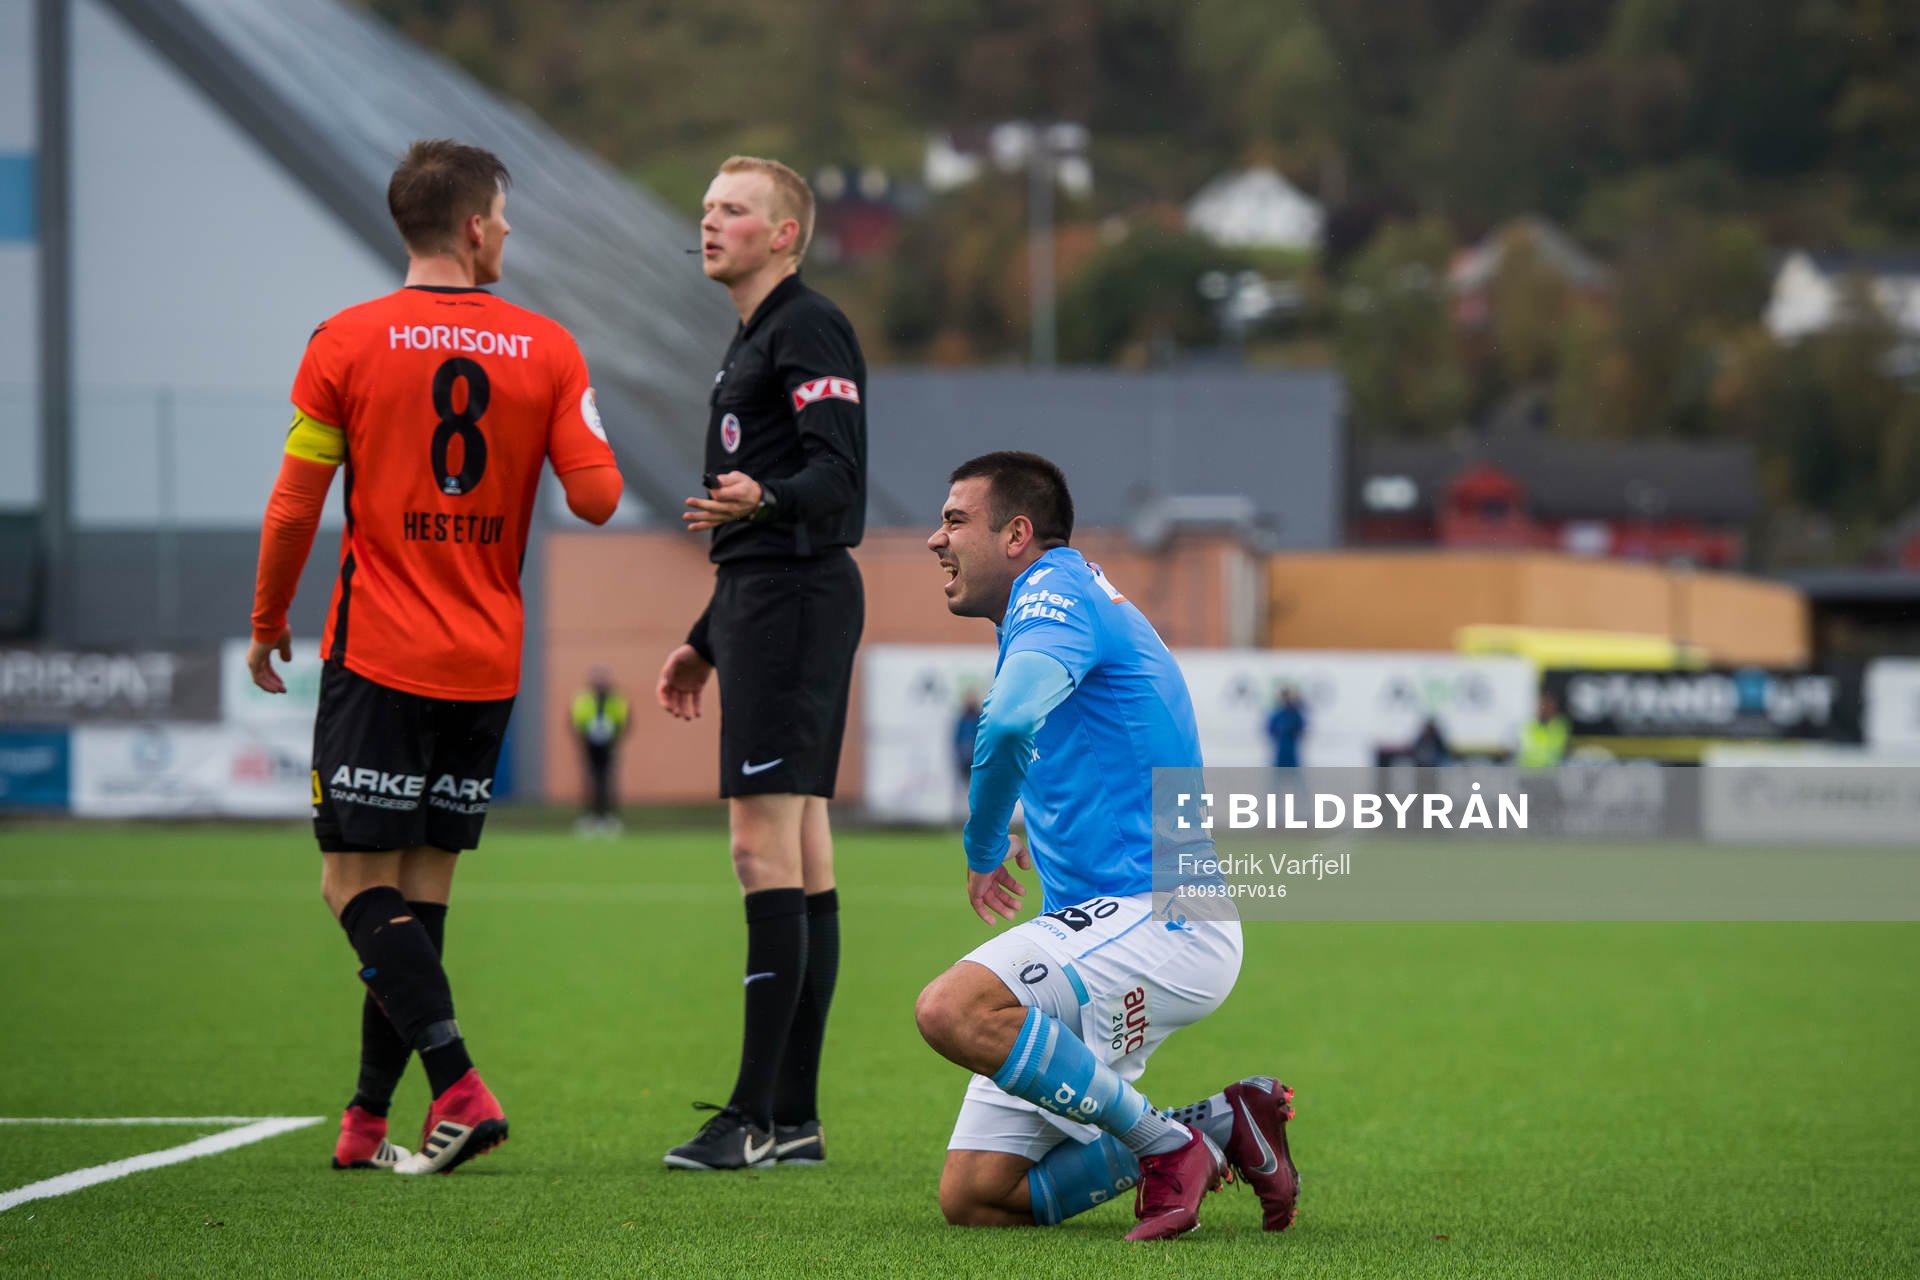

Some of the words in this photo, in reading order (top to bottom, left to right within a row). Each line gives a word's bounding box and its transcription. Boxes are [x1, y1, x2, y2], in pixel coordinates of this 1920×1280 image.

[390, 325, 533, 359] HORISONT
[796, 378, 858, 399] VG
[431, 357, 491, 496] 8
[1020, 602, 1067, 623] Hus
[331, 765, 426, 797] ARKE
[1123, 986, 1151, 1055] auto
